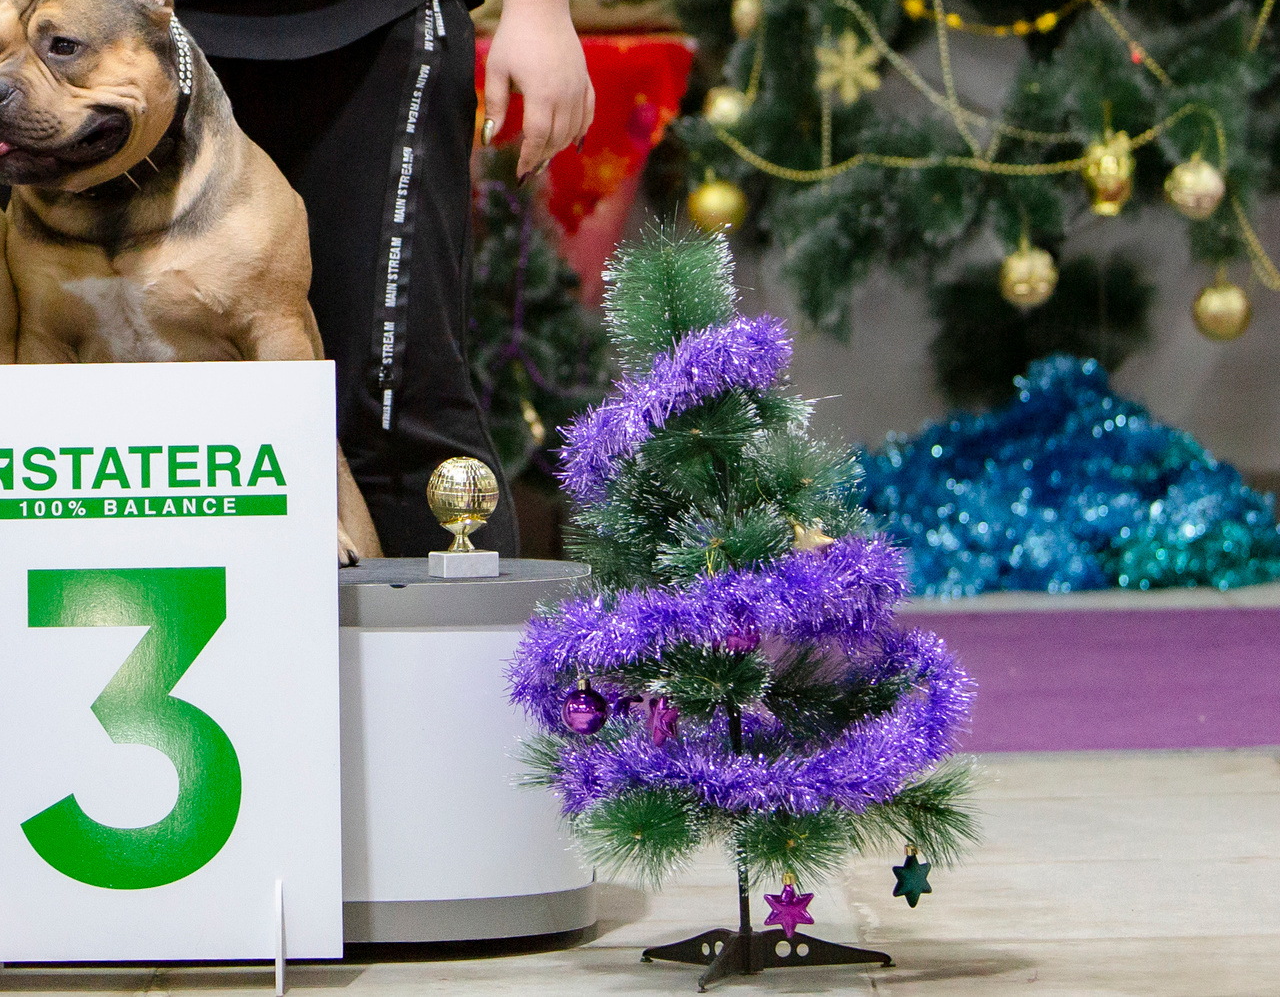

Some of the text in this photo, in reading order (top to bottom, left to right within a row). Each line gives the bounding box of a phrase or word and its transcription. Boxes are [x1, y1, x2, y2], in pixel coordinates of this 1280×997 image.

[424, 9, 434, 51] STREAM
[406, 90, 423, 134] STREAM
[387, 236, 402, 281] STREAM
[382, 321, 395, 364] STREAM
[22, 443, 287, 491] STATERA
[19, 497, 237, 517] 100% BALANCE
[20, 566, 242, 890] 3
